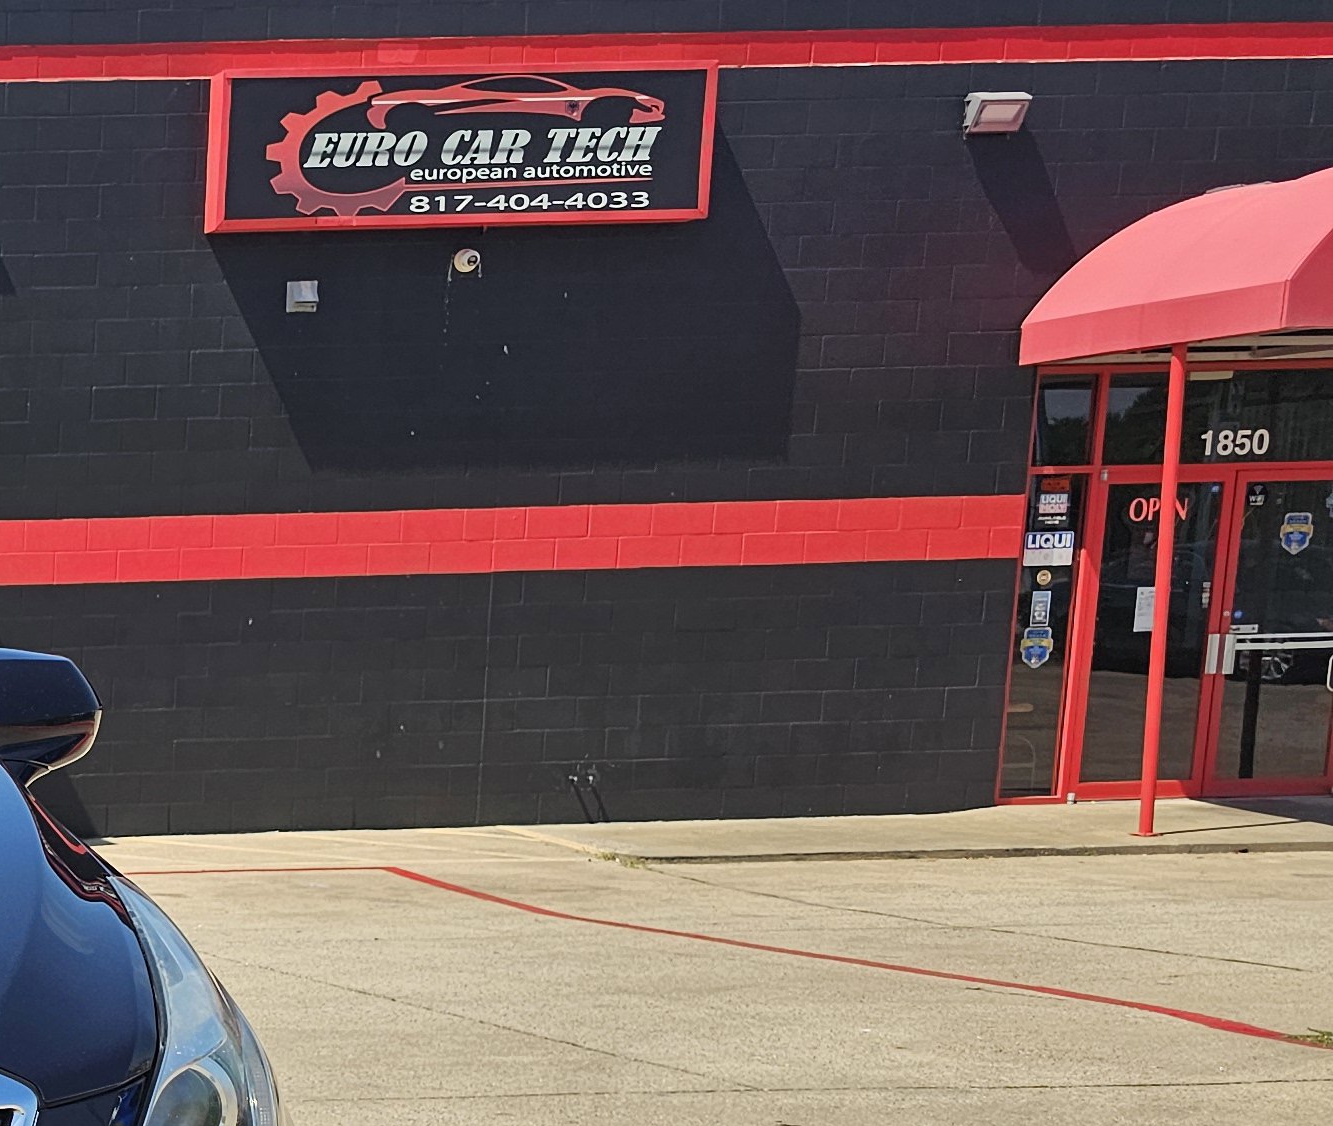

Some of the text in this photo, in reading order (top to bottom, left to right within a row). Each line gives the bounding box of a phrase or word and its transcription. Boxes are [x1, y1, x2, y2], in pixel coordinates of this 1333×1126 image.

[303, 126, 663, 169] EURO CAR TECH
[410, 161, 653, 183] european automotive
[409, 191, 650, 213] 817-404-4033
[1200, 429, 1270, 456] 1850
[1129, 498, 1188, 521] OPN
[1027, 534, 1072, 549] LIQUI
